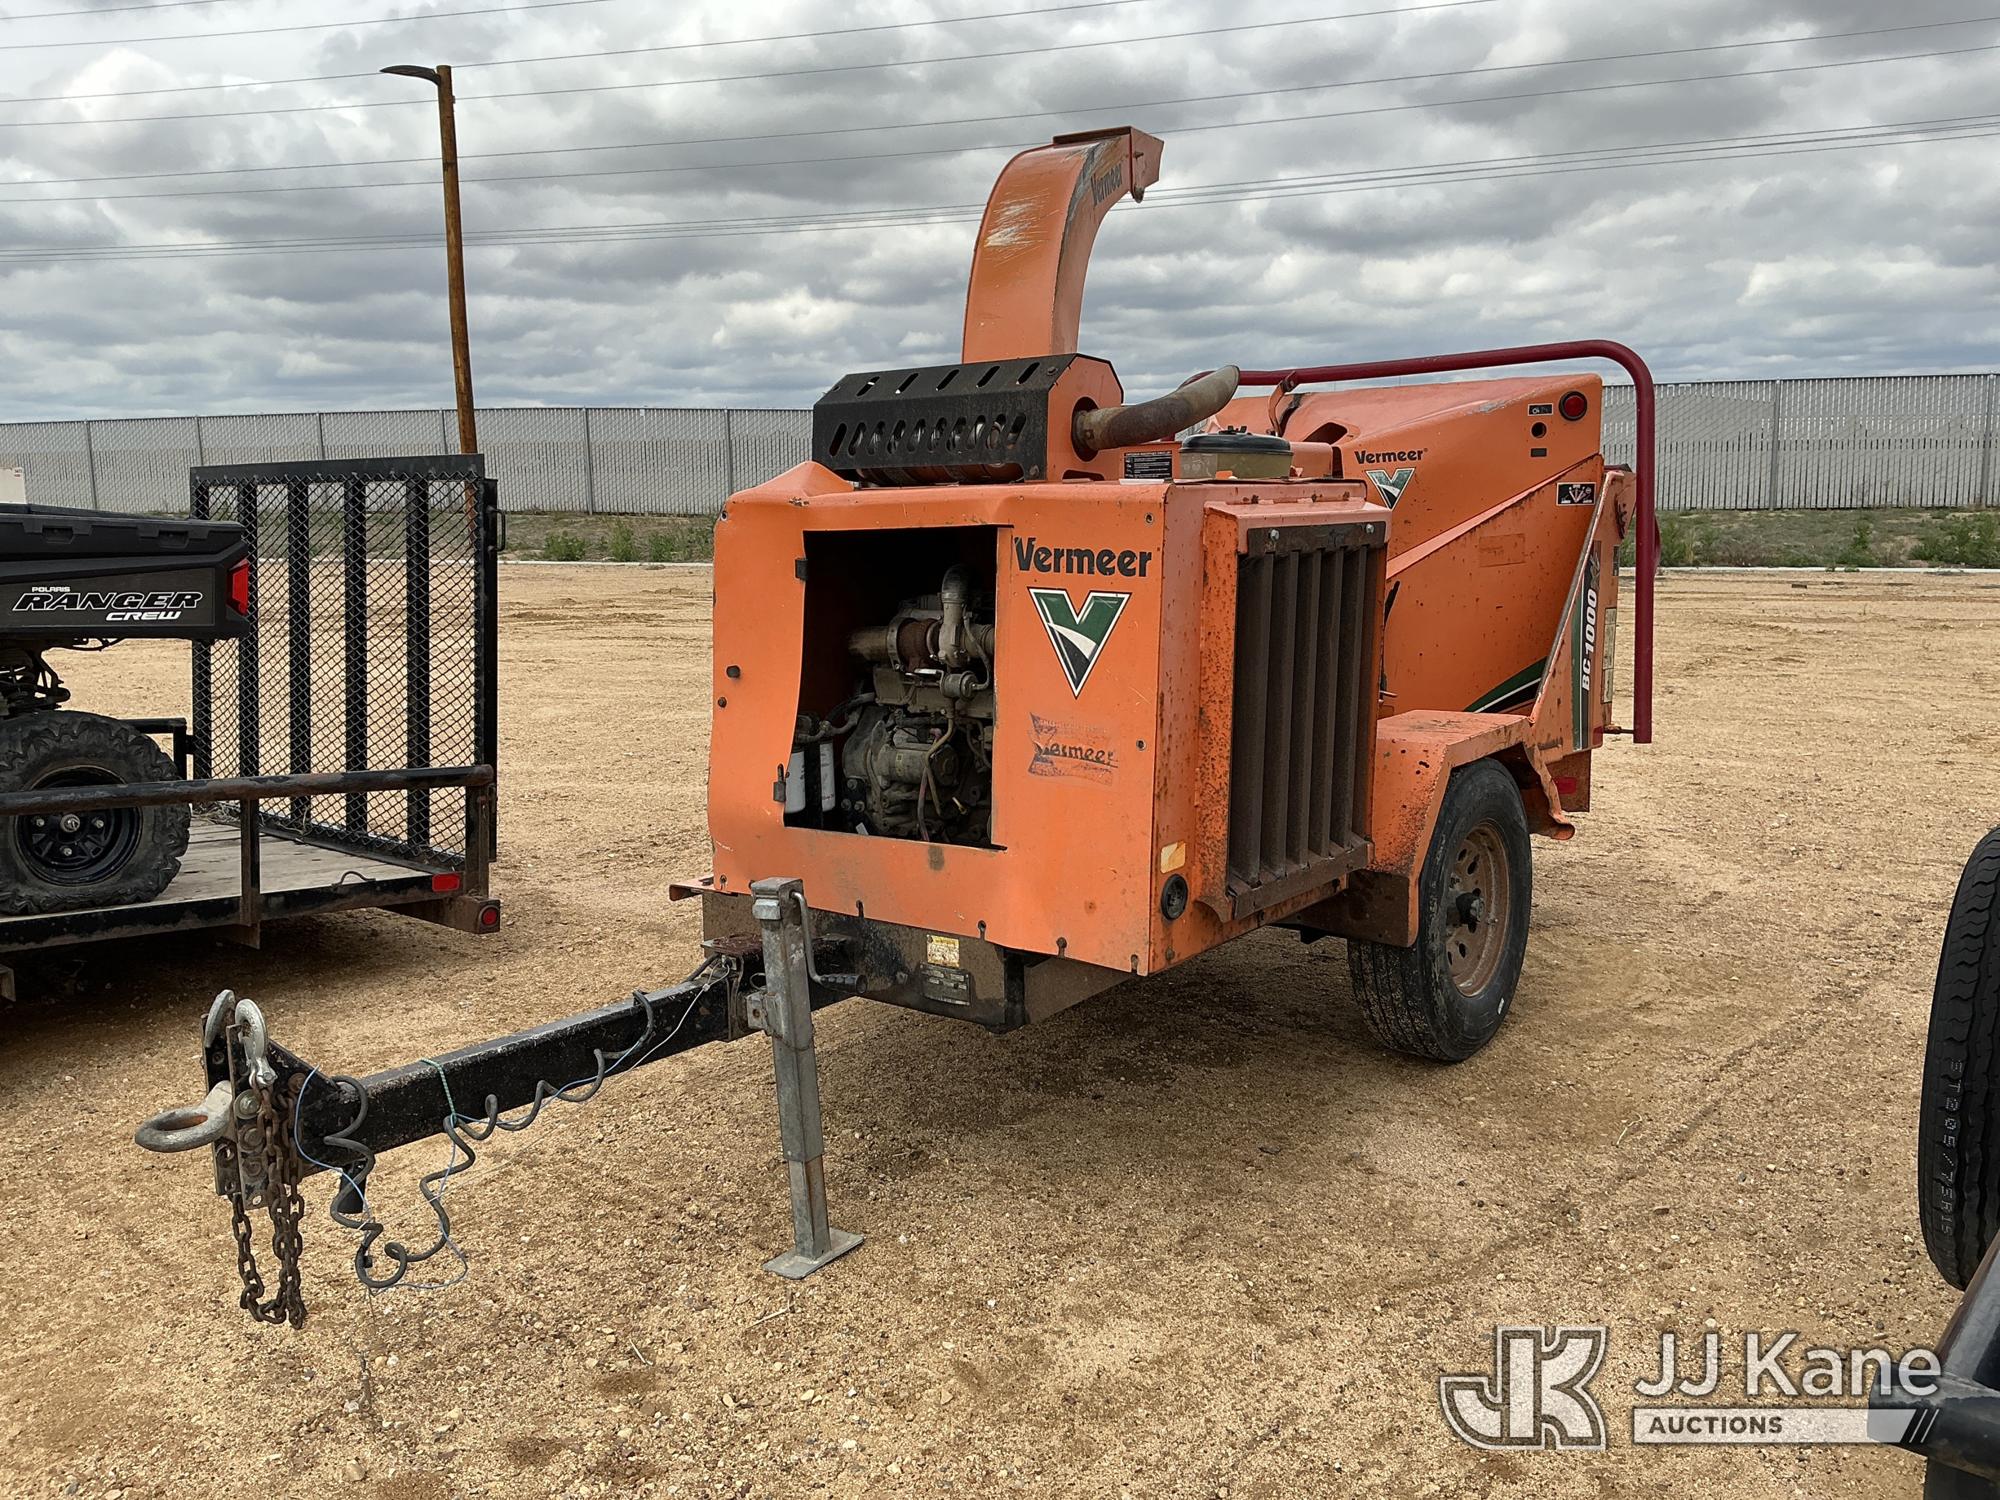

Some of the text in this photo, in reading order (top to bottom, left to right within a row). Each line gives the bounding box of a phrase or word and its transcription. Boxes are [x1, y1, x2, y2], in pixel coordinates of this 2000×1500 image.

[1354, 448, 1425, 464] Vermeer
[1014, 536, 1152, 577] Vermeer
[12, 591, 203, 611] RANGER
[106, 611, 181, 621] CREW
[1585, 588, 1598, 655] 1000
[1581, 657, 1592, 691] BC
